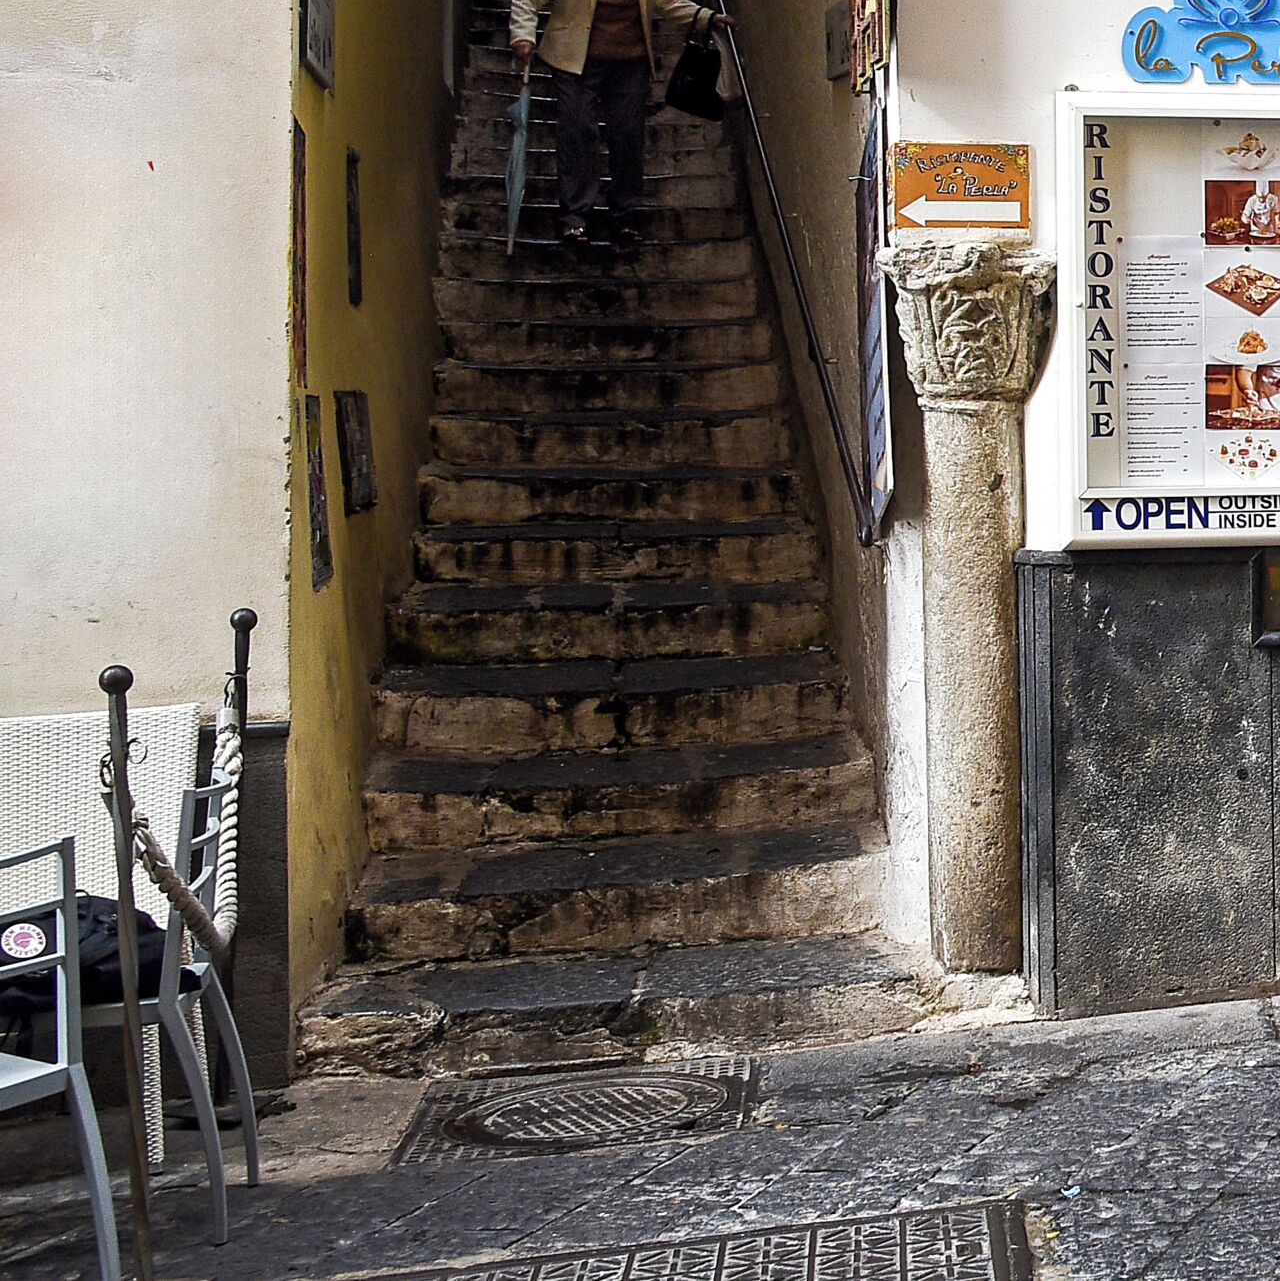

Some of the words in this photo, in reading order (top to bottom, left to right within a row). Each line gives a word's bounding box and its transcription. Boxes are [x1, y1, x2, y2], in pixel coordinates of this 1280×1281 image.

[1084, 123, 1115, 438] RISTORANTE
[1115, 496, 1209, 531] OPEN
[1218, 513, 1275, 529] INSIDE
